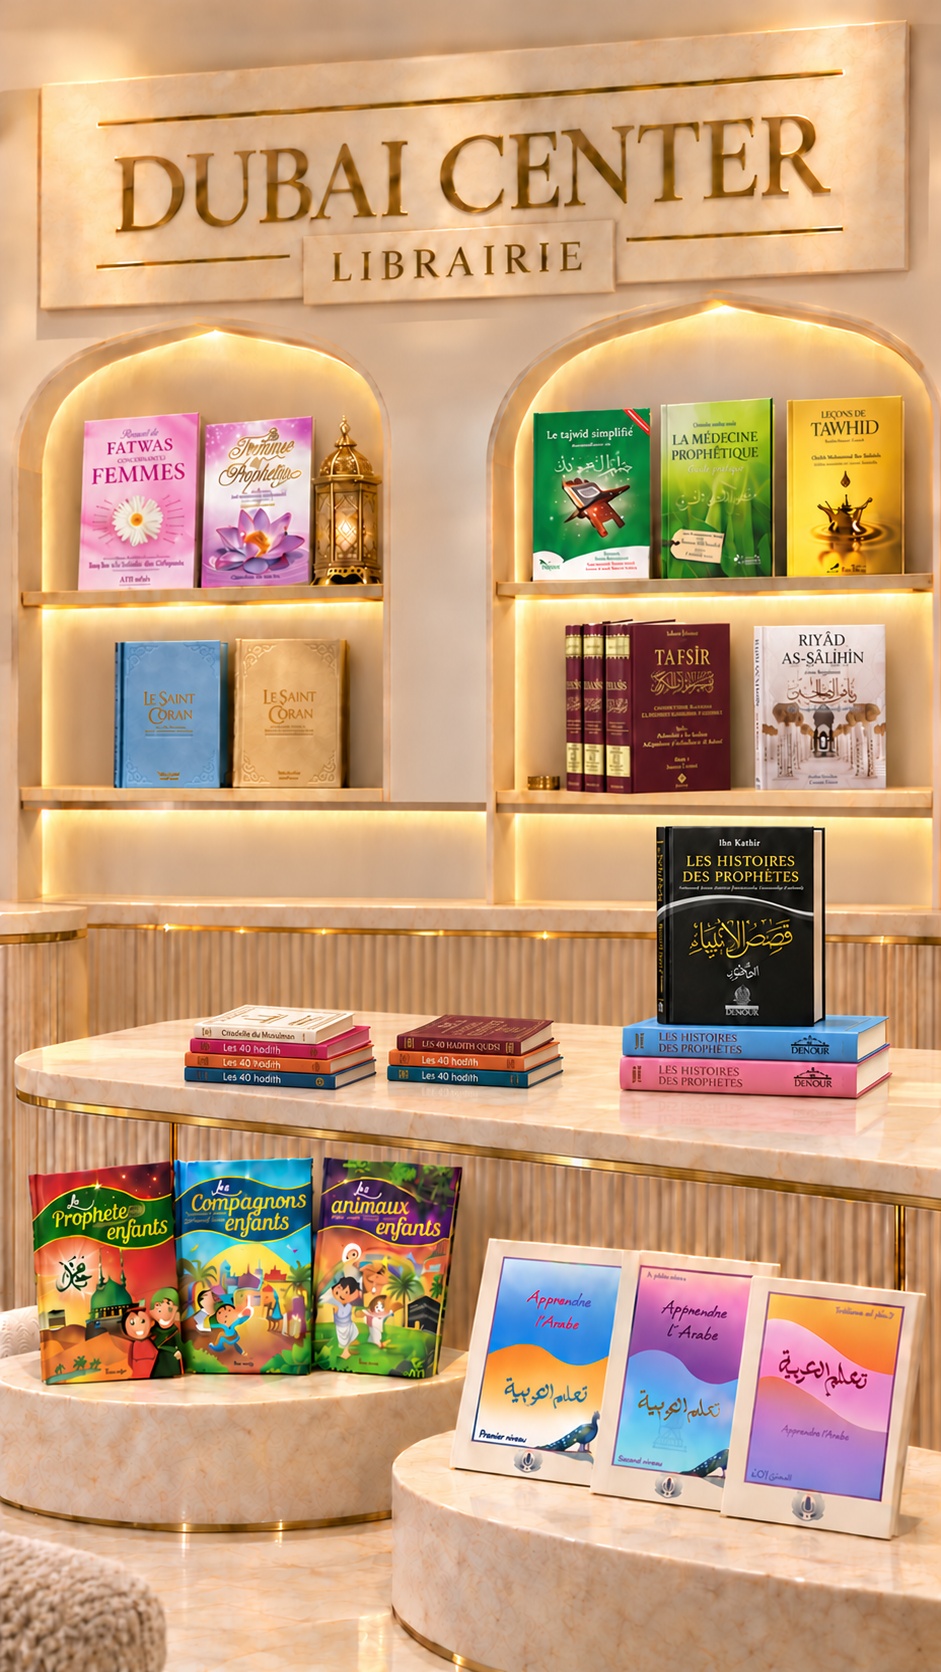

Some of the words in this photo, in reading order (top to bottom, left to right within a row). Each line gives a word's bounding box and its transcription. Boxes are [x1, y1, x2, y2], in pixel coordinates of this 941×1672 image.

[115, 138, 410, 234] DUBAI
[439, 113, 832, 213] CENTER
[332, 240, 584, 283] LIBRAIRIE
[821, 410, 852, 420] LEÇONS
[547, 431, 557, 439] Le
[592, 426, 633, 440] simplifié
[811, 420, 879, 436] TAWHID
[672, 435, 688, 445] LA
[692, 431, 758, 444] MÉDECINE
[107, 438, 173, 455] FATWAS
[91, 463, 185, 485] FEMMES
[799, 631, 845, 646] RIYÂD
[719, 839, 731, 847] Ibn
[735, 839, 761, 847] Kathir
[687, 856, 712, 867] LES
[717, 855, 795, 867] HISTOIRES
[682, 871, 710, 883] DES
[659, 1032, 677, 1041] LES
[681, 1033, 737, 1042] HISTOIRES
[223, 1044, 237, 1052] Les
[239, 1045, 251, 1053] 40
[659, 1044, 678, 1052] DES
[792, 1047, 829, 1055] DENOUR
[239, 1059, 251, 1067] 40
[422, 1056, 435, 1064] Les
[438, 1056, 449, 1065] 40
[422, 1071, 435, 1080] Les
[438, 1072, 449, 1080] 40
[659, 1065, 677, 1074] LES
[681, 1066, 739, 1076] HISTOIRES
[223, 1073, 237, 1081] Les
[239, 1073, 251, 1081] 40
[659, 1076, 678, 1085] DES
[795, 1079, 832, 1087] DENOUR
[191, 1193, 307, 1216] Compagnons
[331, 1197, 409, 1215] animaux
[225, 1212, 289, 1238] enfants
[376, 1217, 441, 1242] enfants
[107, 1219, 168, 1244] enfants
[505, 1434, 527, 1443] niveau
